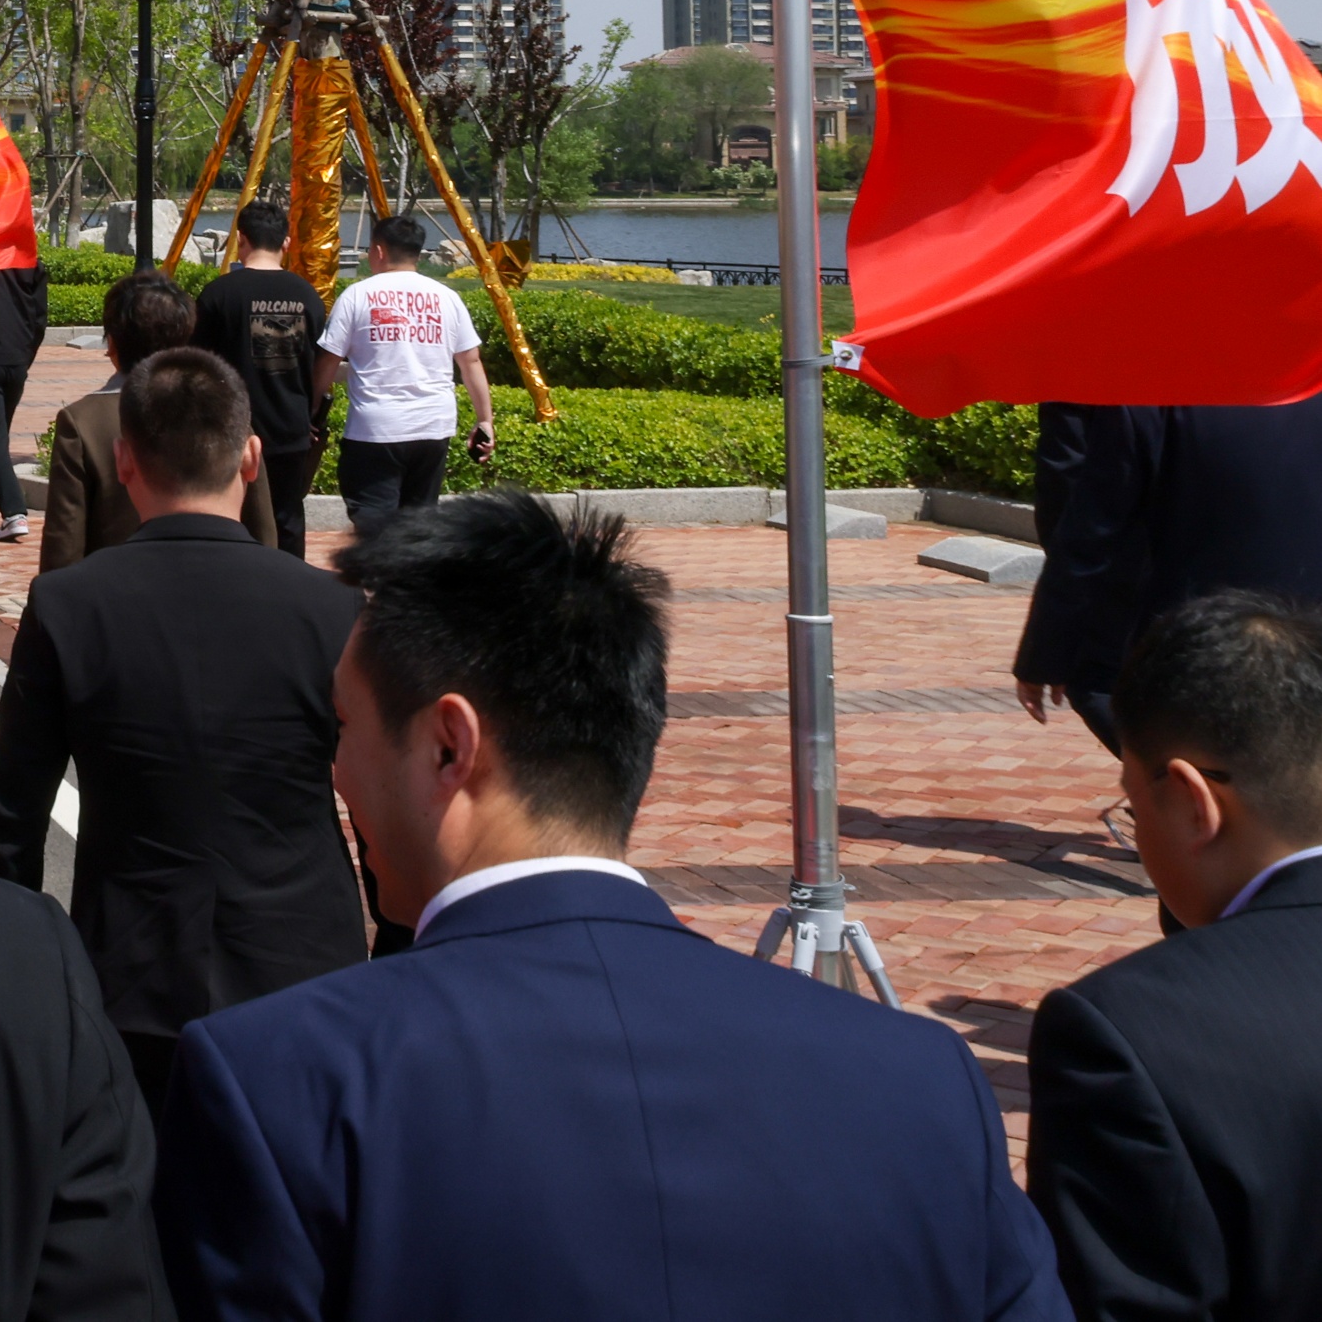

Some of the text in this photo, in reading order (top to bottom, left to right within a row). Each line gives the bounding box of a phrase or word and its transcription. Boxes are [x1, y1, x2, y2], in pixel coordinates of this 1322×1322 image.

[251, 300, 305, 313] VOLCANO
[366, 290, 442, 317] MORE ROAR
[417, 314, 442, 325] IN
[369, 325, 443, 344] EVERY POUR
